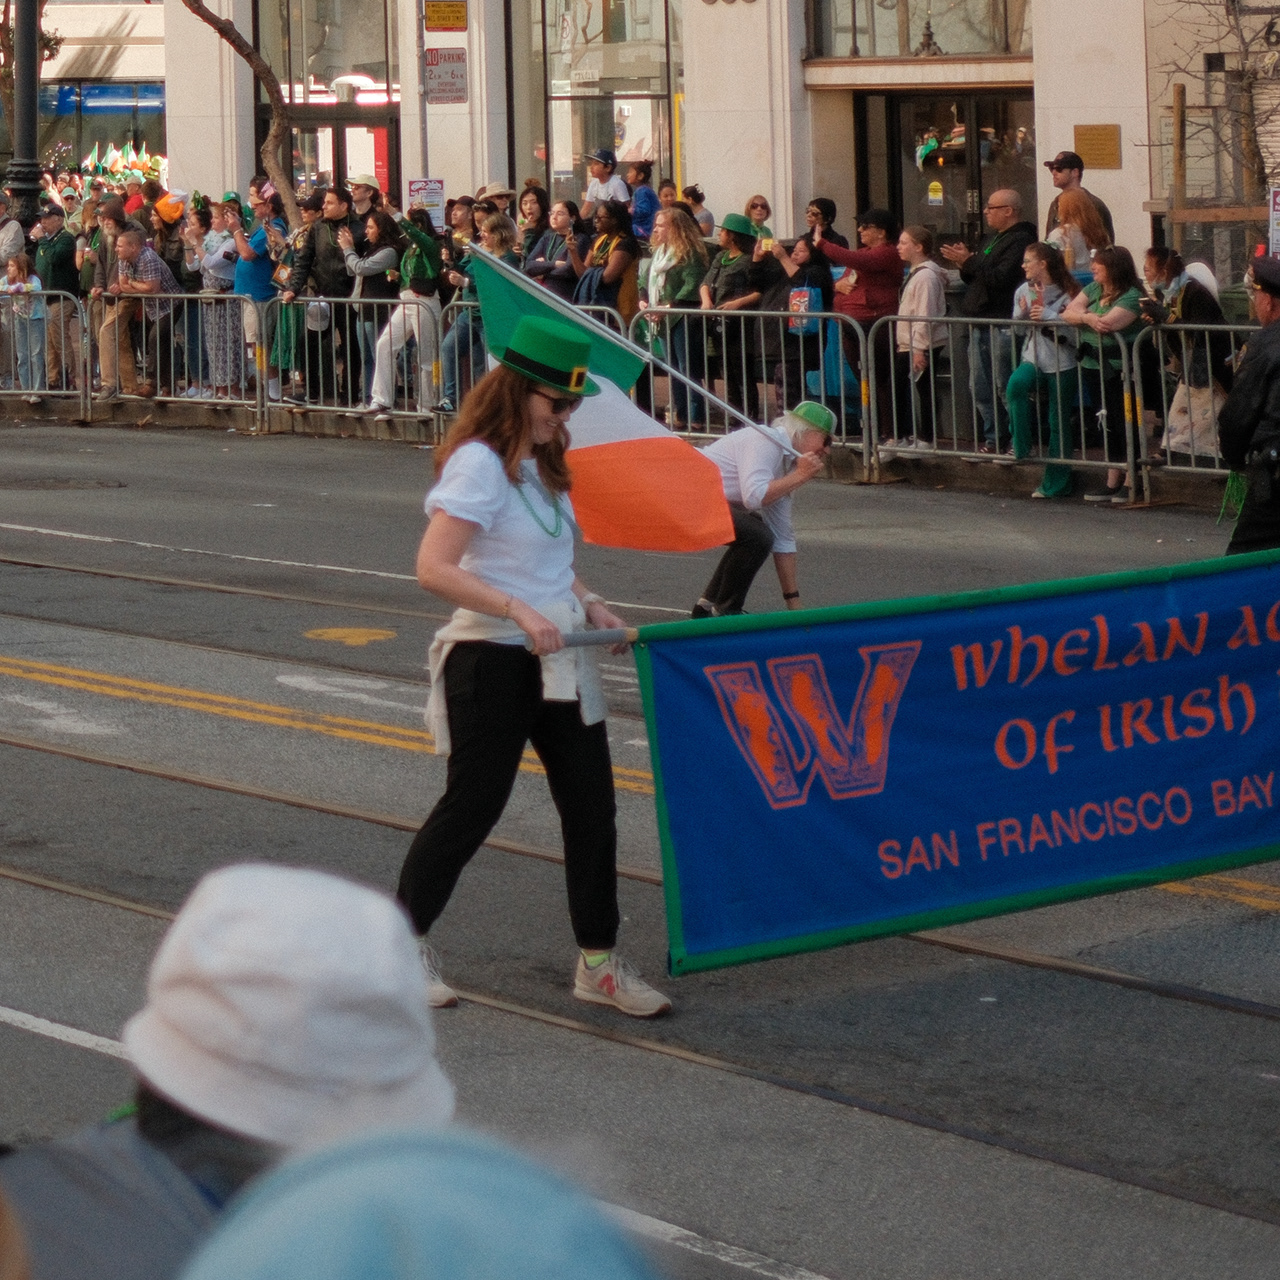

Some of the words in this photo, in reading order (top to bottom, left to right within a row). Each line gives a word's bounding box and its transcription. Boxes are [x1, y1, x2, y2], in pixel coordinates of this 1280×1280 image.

[703, 640, 922, 810] W
[995, 709, 1076, 774] OF
[877, 830, 959, 879] SAN
[976, 786, 1193, 861] FRANCISCO
[1211, 771, 1275, 817] BAY
